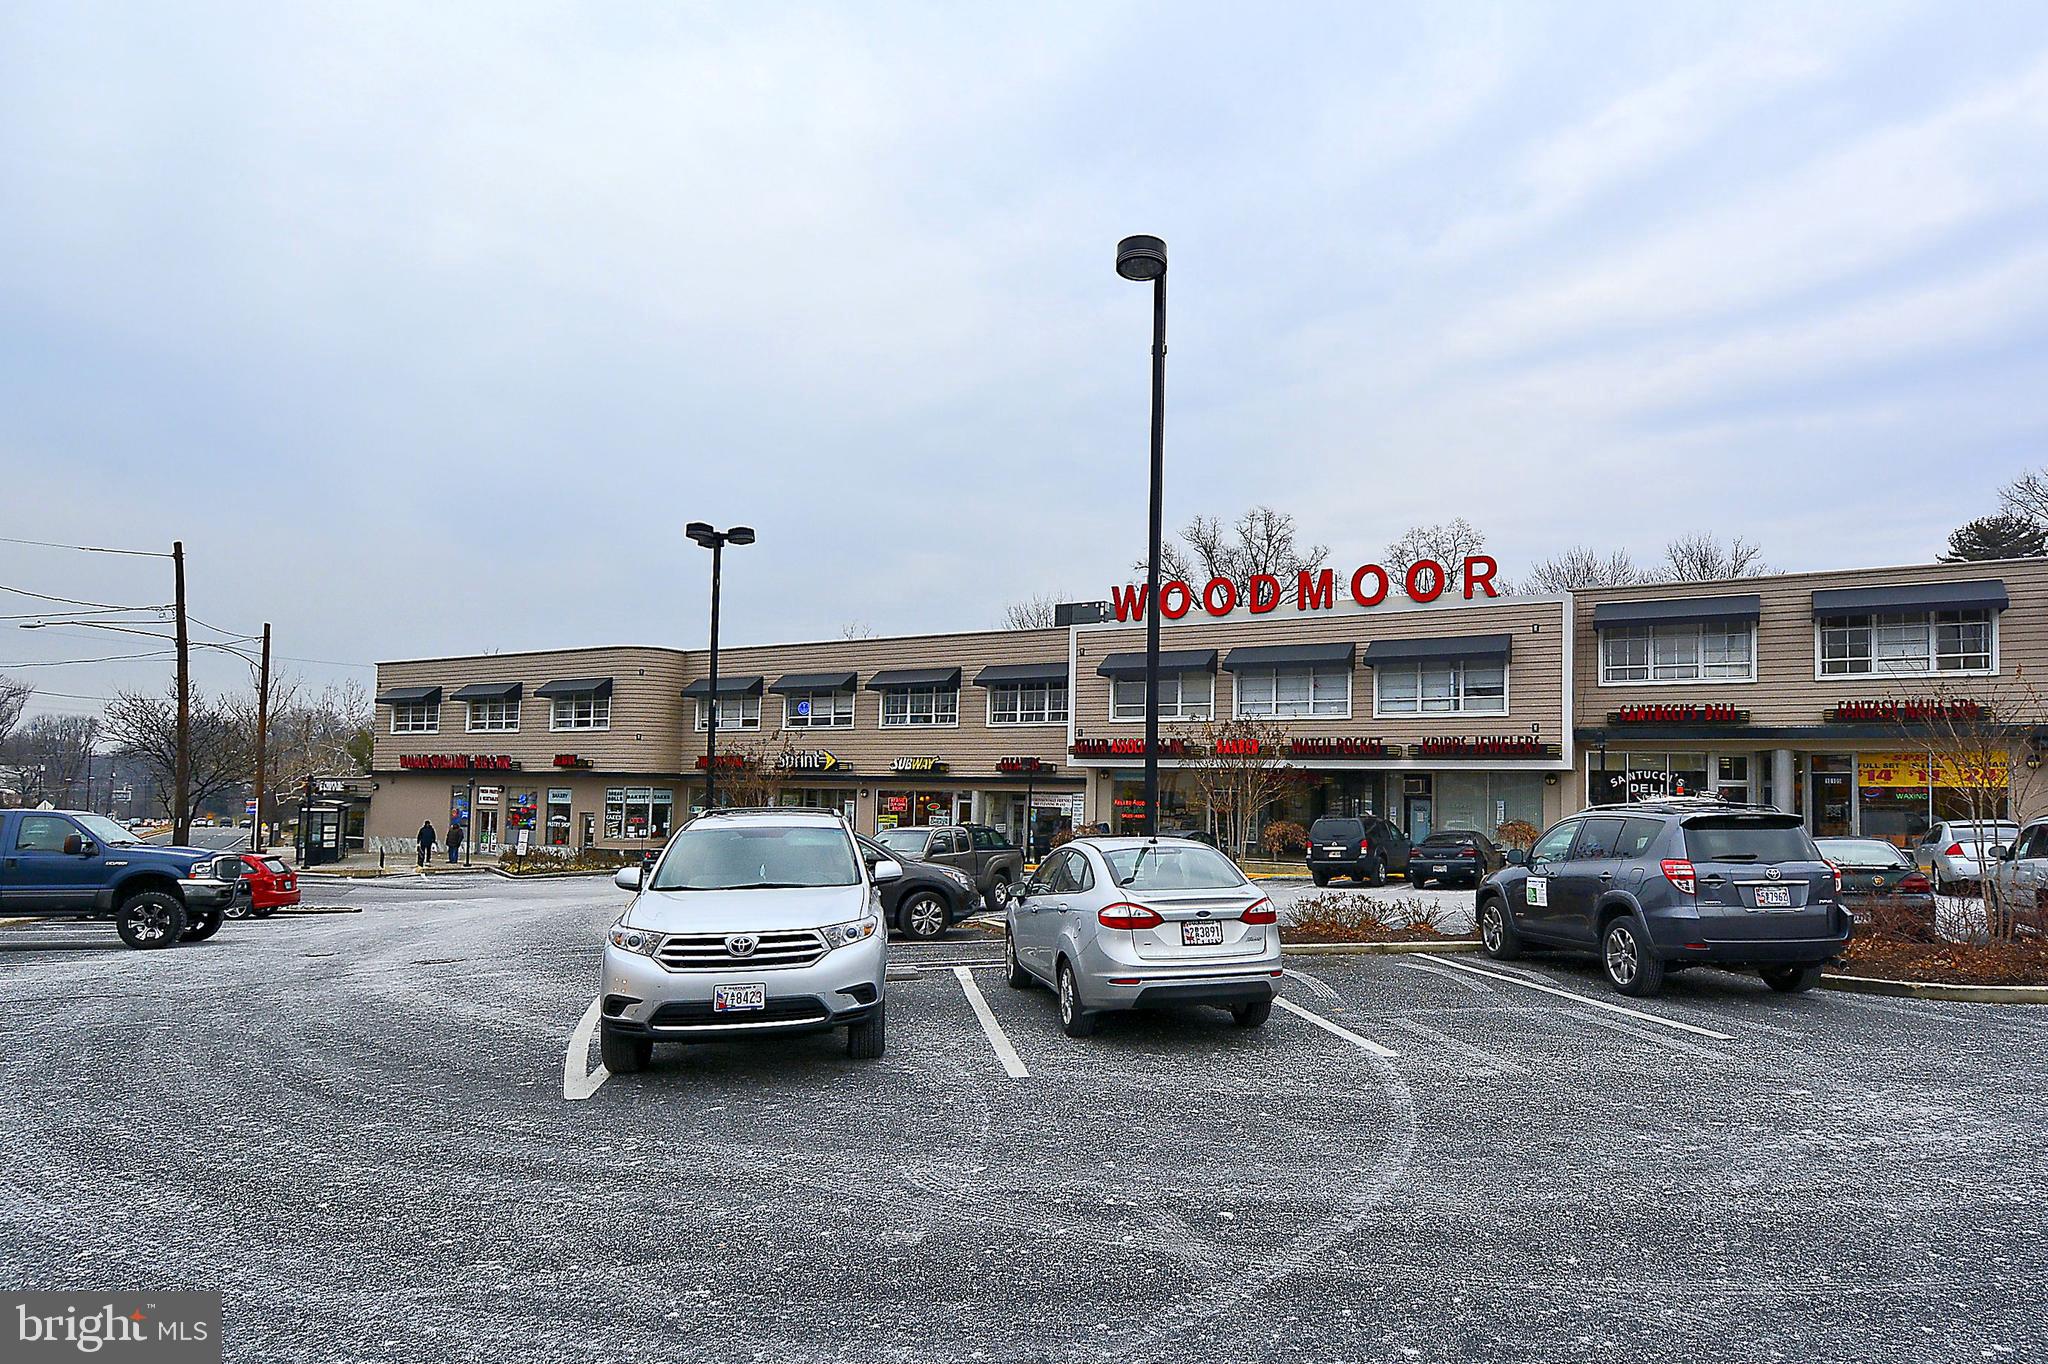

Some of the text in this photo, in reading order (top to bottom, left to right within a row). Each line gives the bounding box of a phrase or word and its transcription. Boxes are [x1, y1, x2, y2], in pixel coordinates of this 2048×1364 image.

[1111, 555, 1500, 622] WOODMOOR
[1619, 703, 1736, 721] SANTUCCI'S DELI
[1838, 699, 1901, 720] FANTASY
[1905, 698, 1944, 719] NAILS
[1075, 738, 1108, 754] KELLER
[1216, 738, 1260, 755] BARBER
[1291, 737, 1383, 754] WATCH POCKET
[1422, 735, 1540, 754] KRIPPS JEWELERS
[891, 756, 941, 771] SUBWAY
[1610, 769, 1686, 788] SANTUCCI'S
[1631, 783, 1664, 793] DELI
[1895, 793, 1929, 801] WAXING
